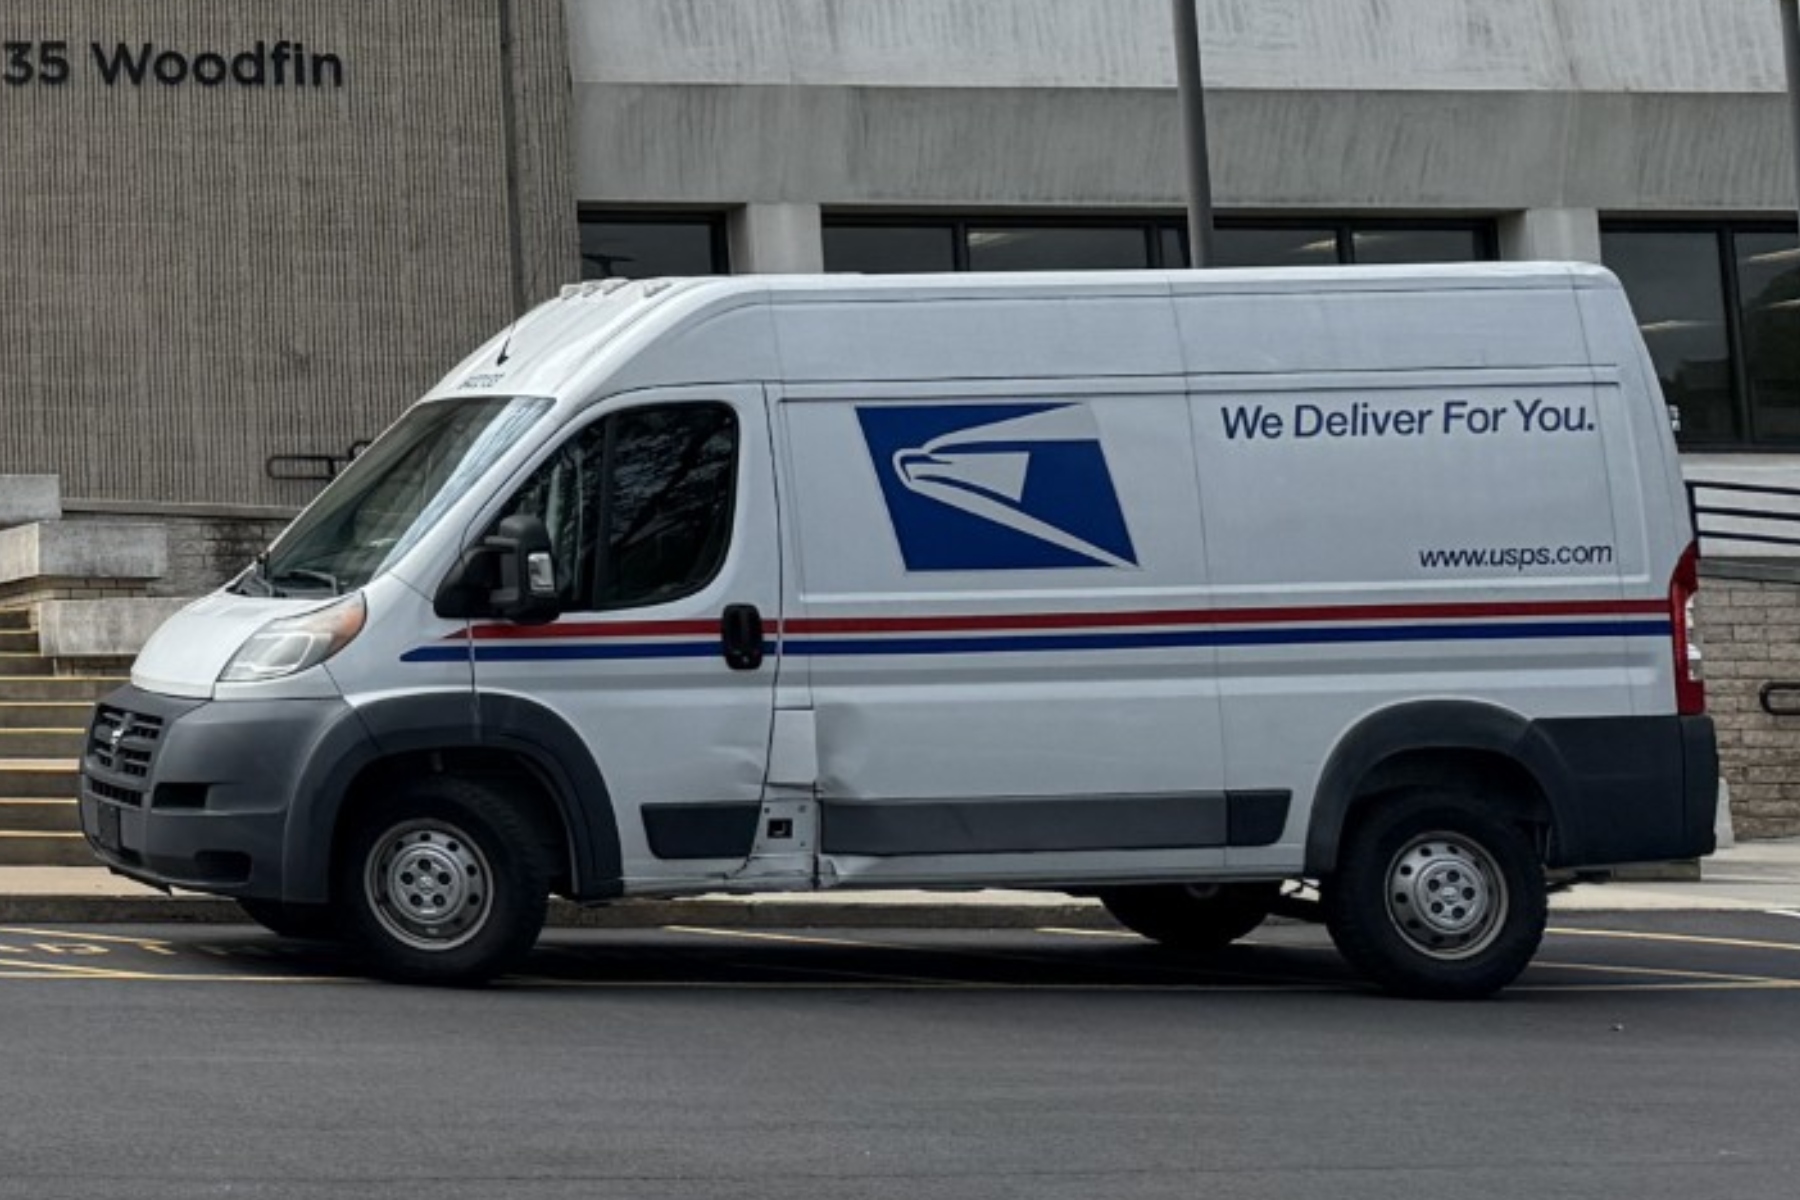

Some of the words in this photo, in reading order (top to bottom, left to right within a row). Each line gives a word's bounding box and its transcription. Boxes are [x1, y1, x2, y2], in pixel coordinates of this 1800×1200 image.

[3, 40, 70, 86] 35
[91, 40, 343, 87] Woodfin
[1221, 405, 1284, 440] We
[1294, 402, 1433, 438] Deliver
[1443, 400, 1506, 435] For
[1514, 399, 1595, 433] You.
[1419, 544, 1612, 570] www.usps.com
